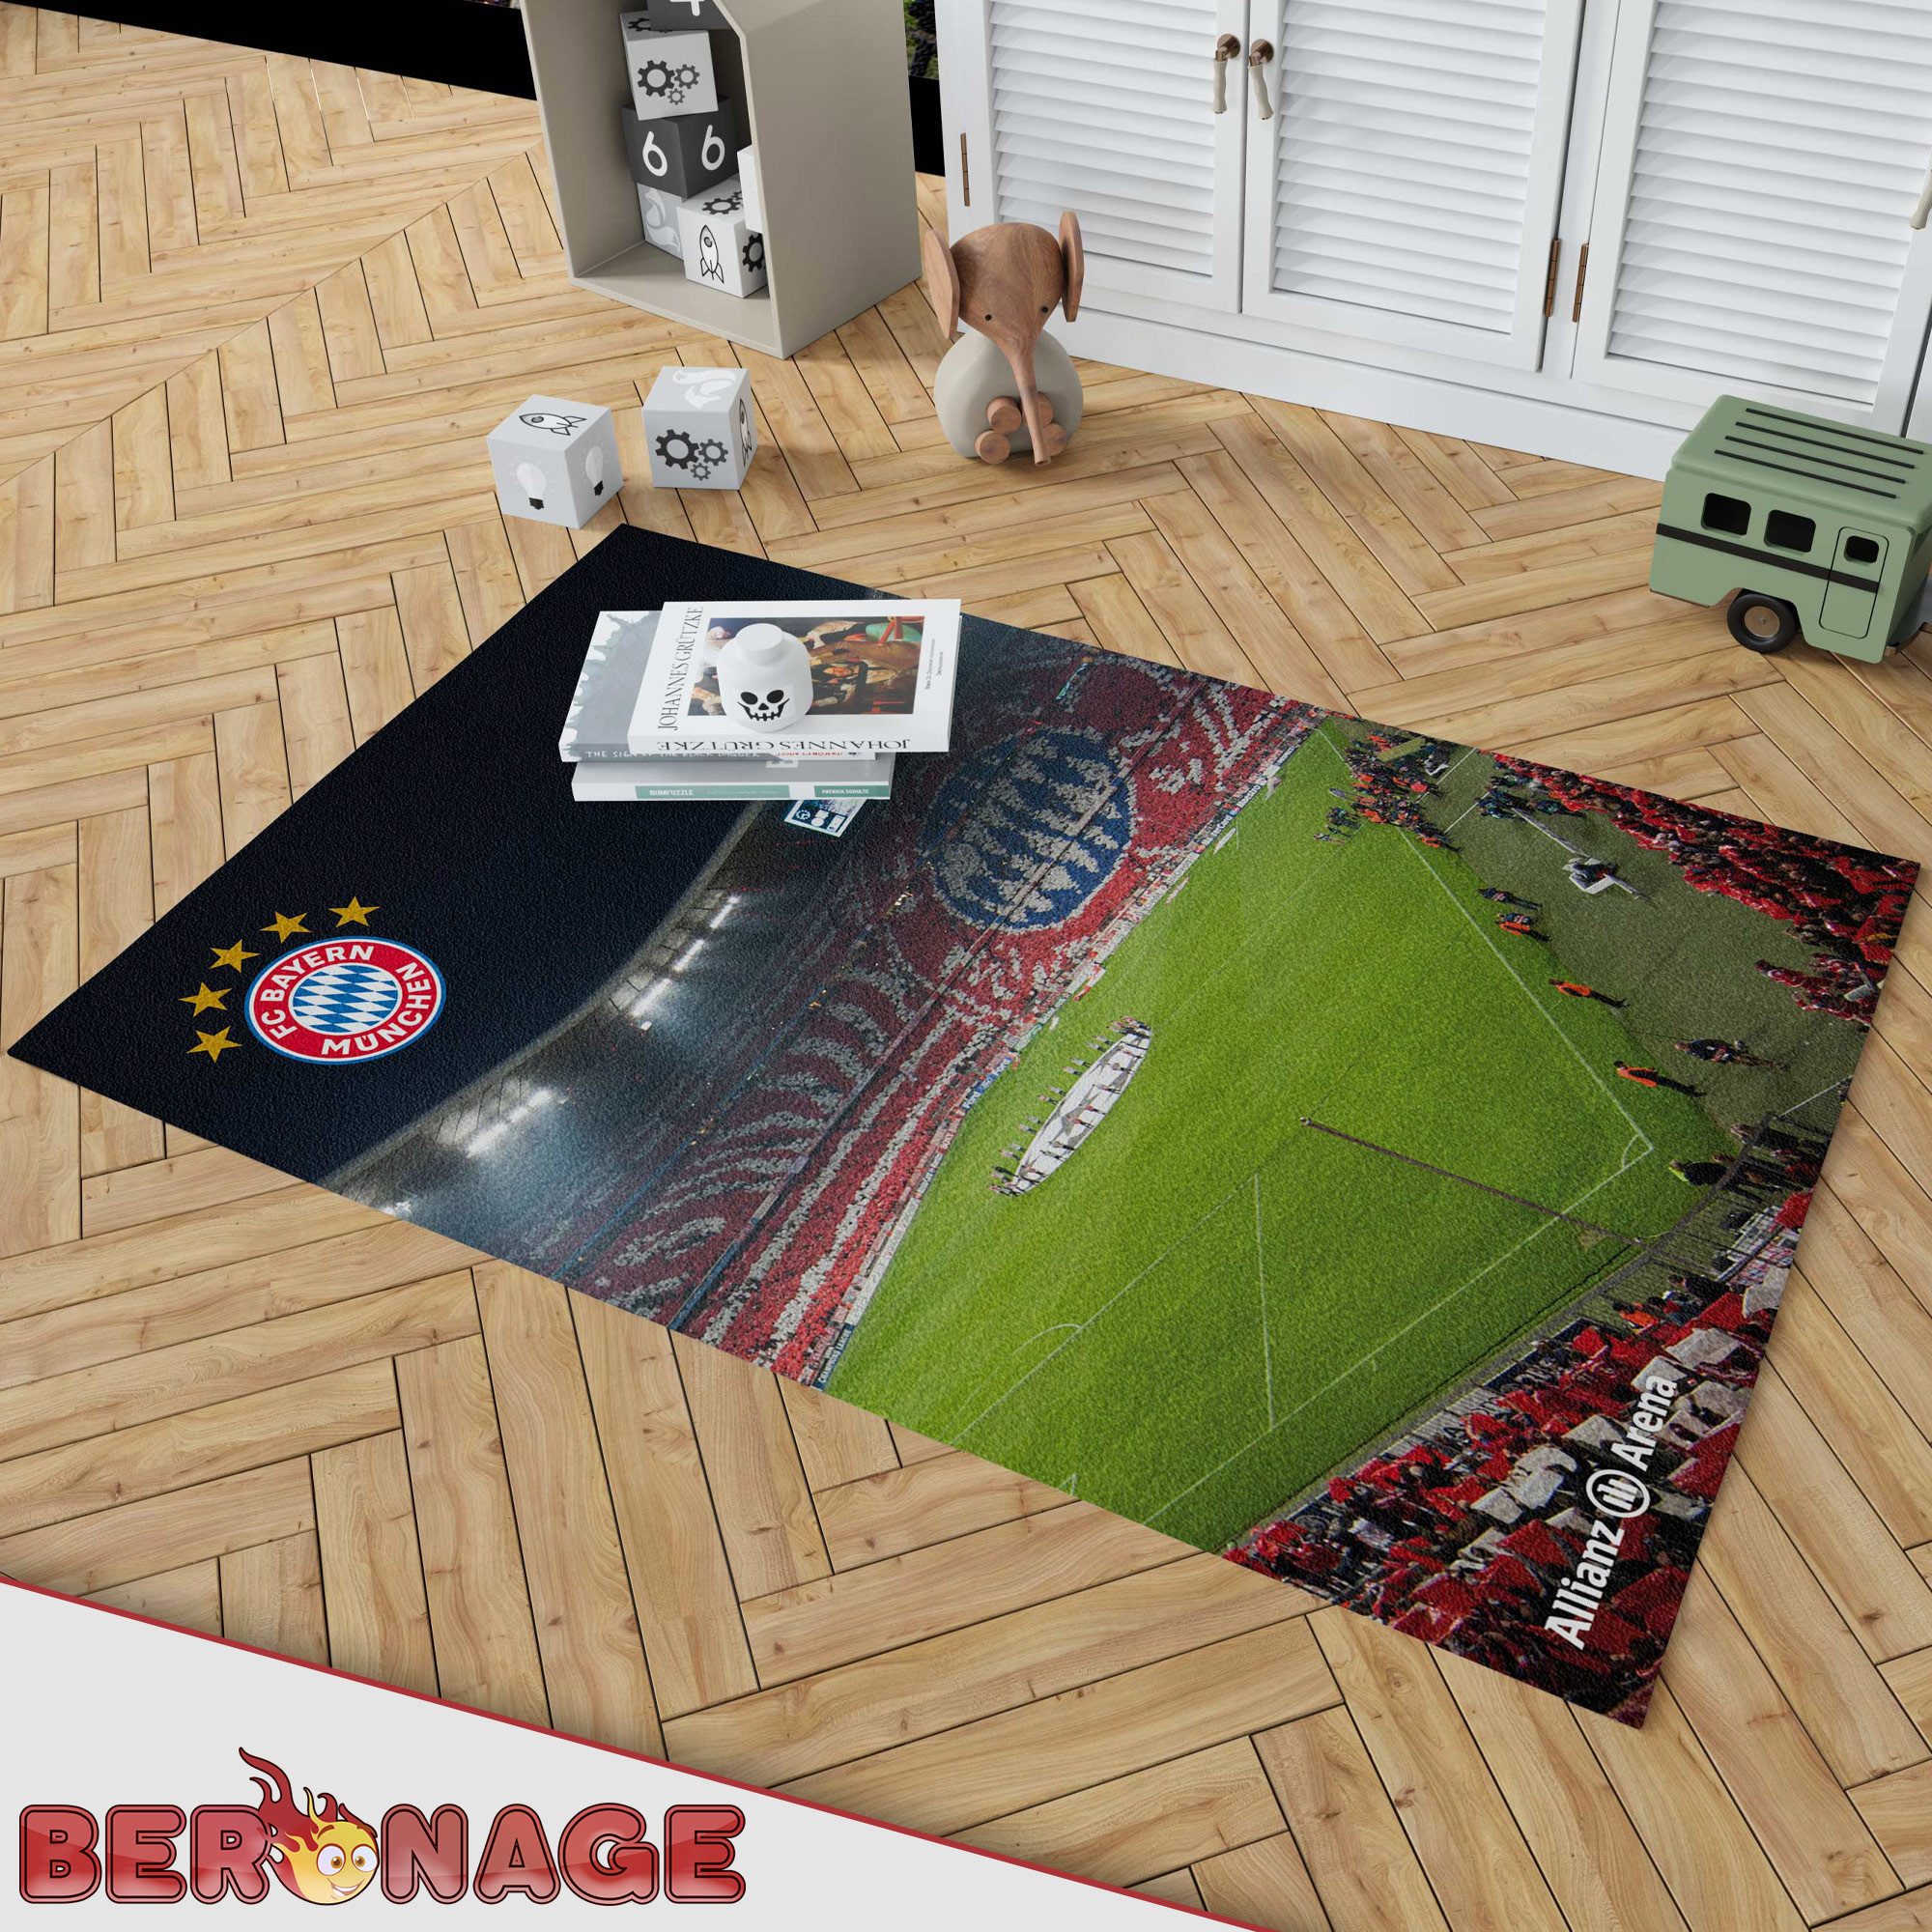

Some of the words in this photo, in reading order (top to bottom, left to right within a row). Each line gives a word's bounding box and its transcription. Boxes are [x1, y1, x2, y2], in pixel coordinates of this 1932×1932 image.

[642, 130, 668, 177] 6
[701, 125, 725, 171] 6
[658, 663, 689, 731] JOHANNES
[675, 607, 703, 661] GRÜTZKE
[779, 740, 911, 751] JOHANNES
[260, 945, 375, 1002] BAYERN
[261, 1009, 298, 1040] FC
[321, 962, 433, 1055] MÜNCHEN
[1544, 1519, 1626, 1651] Allianz
[1610, 1375, 1678, 1472] Arena
